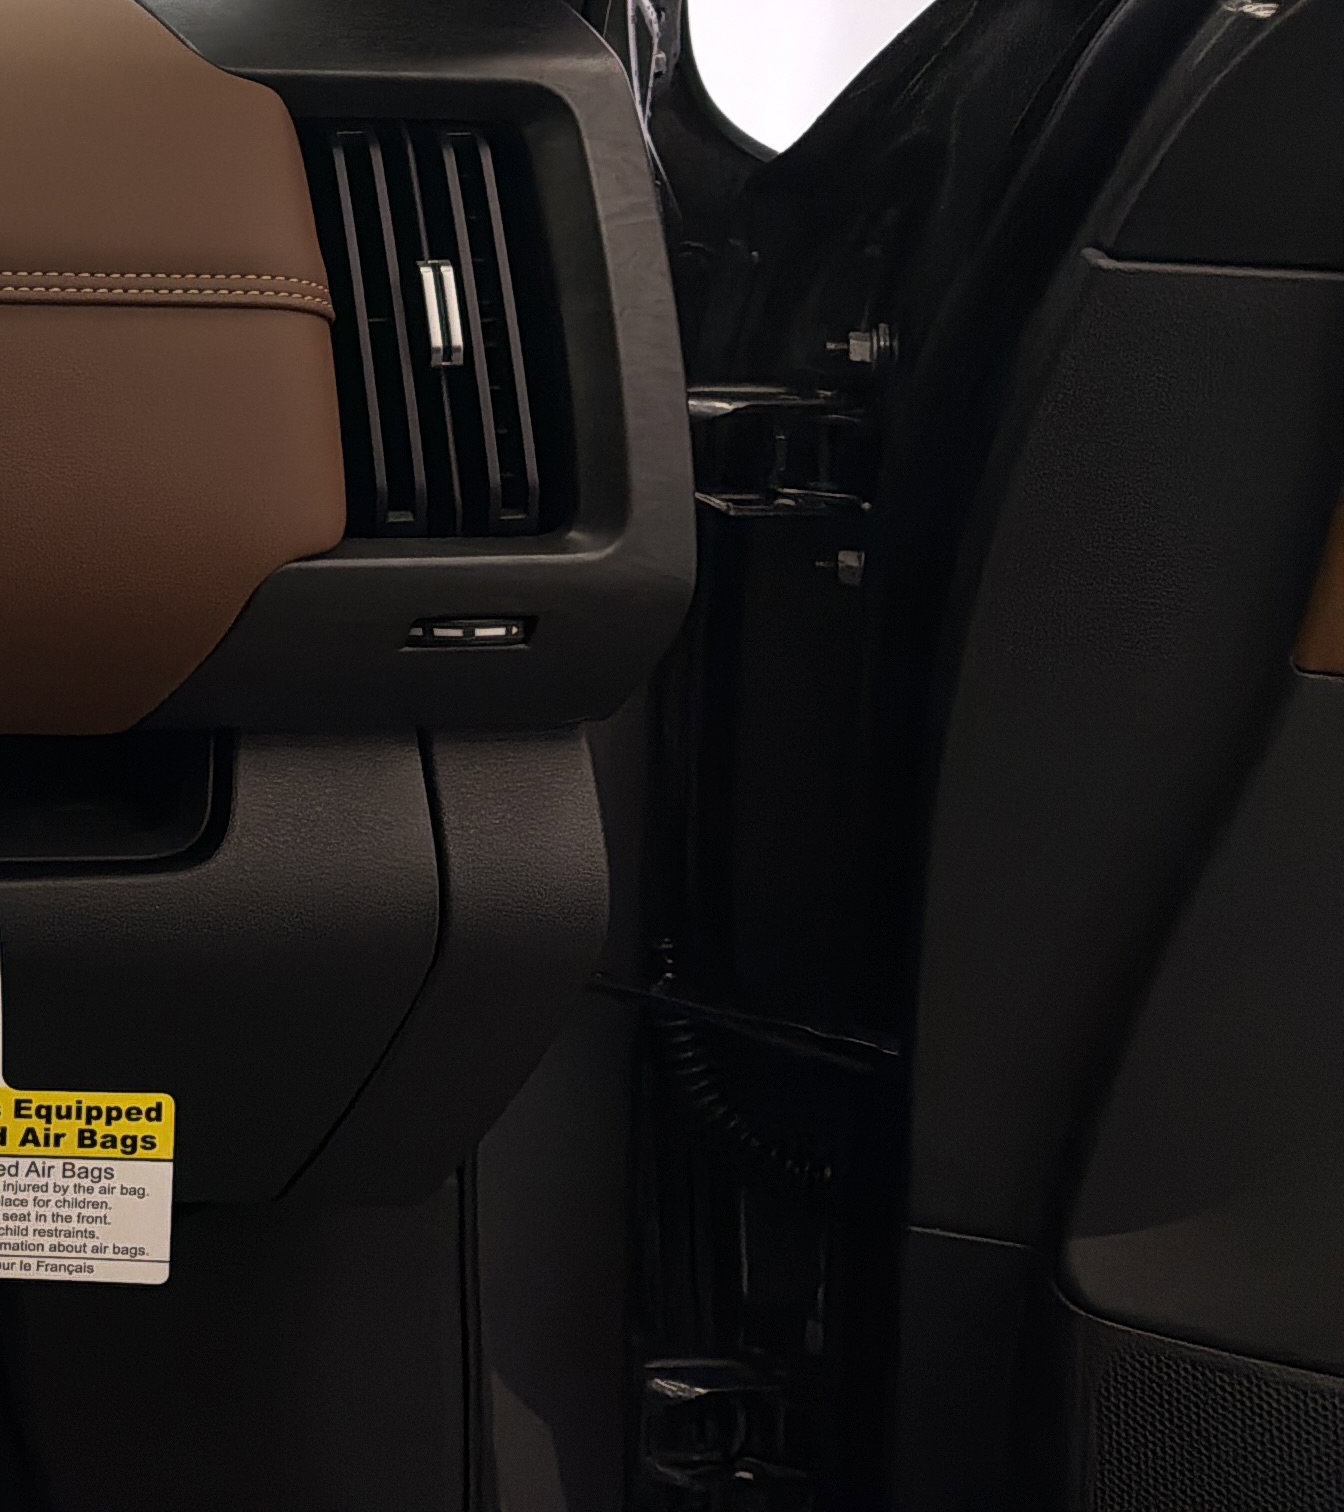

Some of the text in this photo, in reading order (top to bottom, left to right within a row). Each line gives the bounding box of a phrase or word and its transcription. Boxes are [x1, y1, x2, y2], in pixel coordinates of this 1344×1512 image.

[14, 1099, 162, 1126] Equipped
[18, 1127, 66, 1148] Air
[77, 1128, 157, 1155] Bags
[25, 1160, 55, 1178] Air
[62, 1162, 115, 1183] Bags
[3, 1181, 49, 1196] injured
[53, 1182, 69, 1196] by
[73, 1183, 94, 1195] the
[98, 1184, 116, 1196] air
[120, 1185, 150, 1199] bag.
[33, 1197, 52, 1208] for
[54, 1198, 112, 1211] children.
[2, 1211, 31, 1223] seat
[35, 1211, 47, 1223] in
[51, 1212, 73, 1224] the
[76, 1213, 112, 1226] front.
[32, 1227, 100, 1240] restraints.
[48, 1241, 88, 1254] about
[91, 1242, 109, 1255] air
[112, 1243, 150, 1258] bags.
[19, 1259, 32, 1271] le
[36, 1261, 95, 1275] Français
